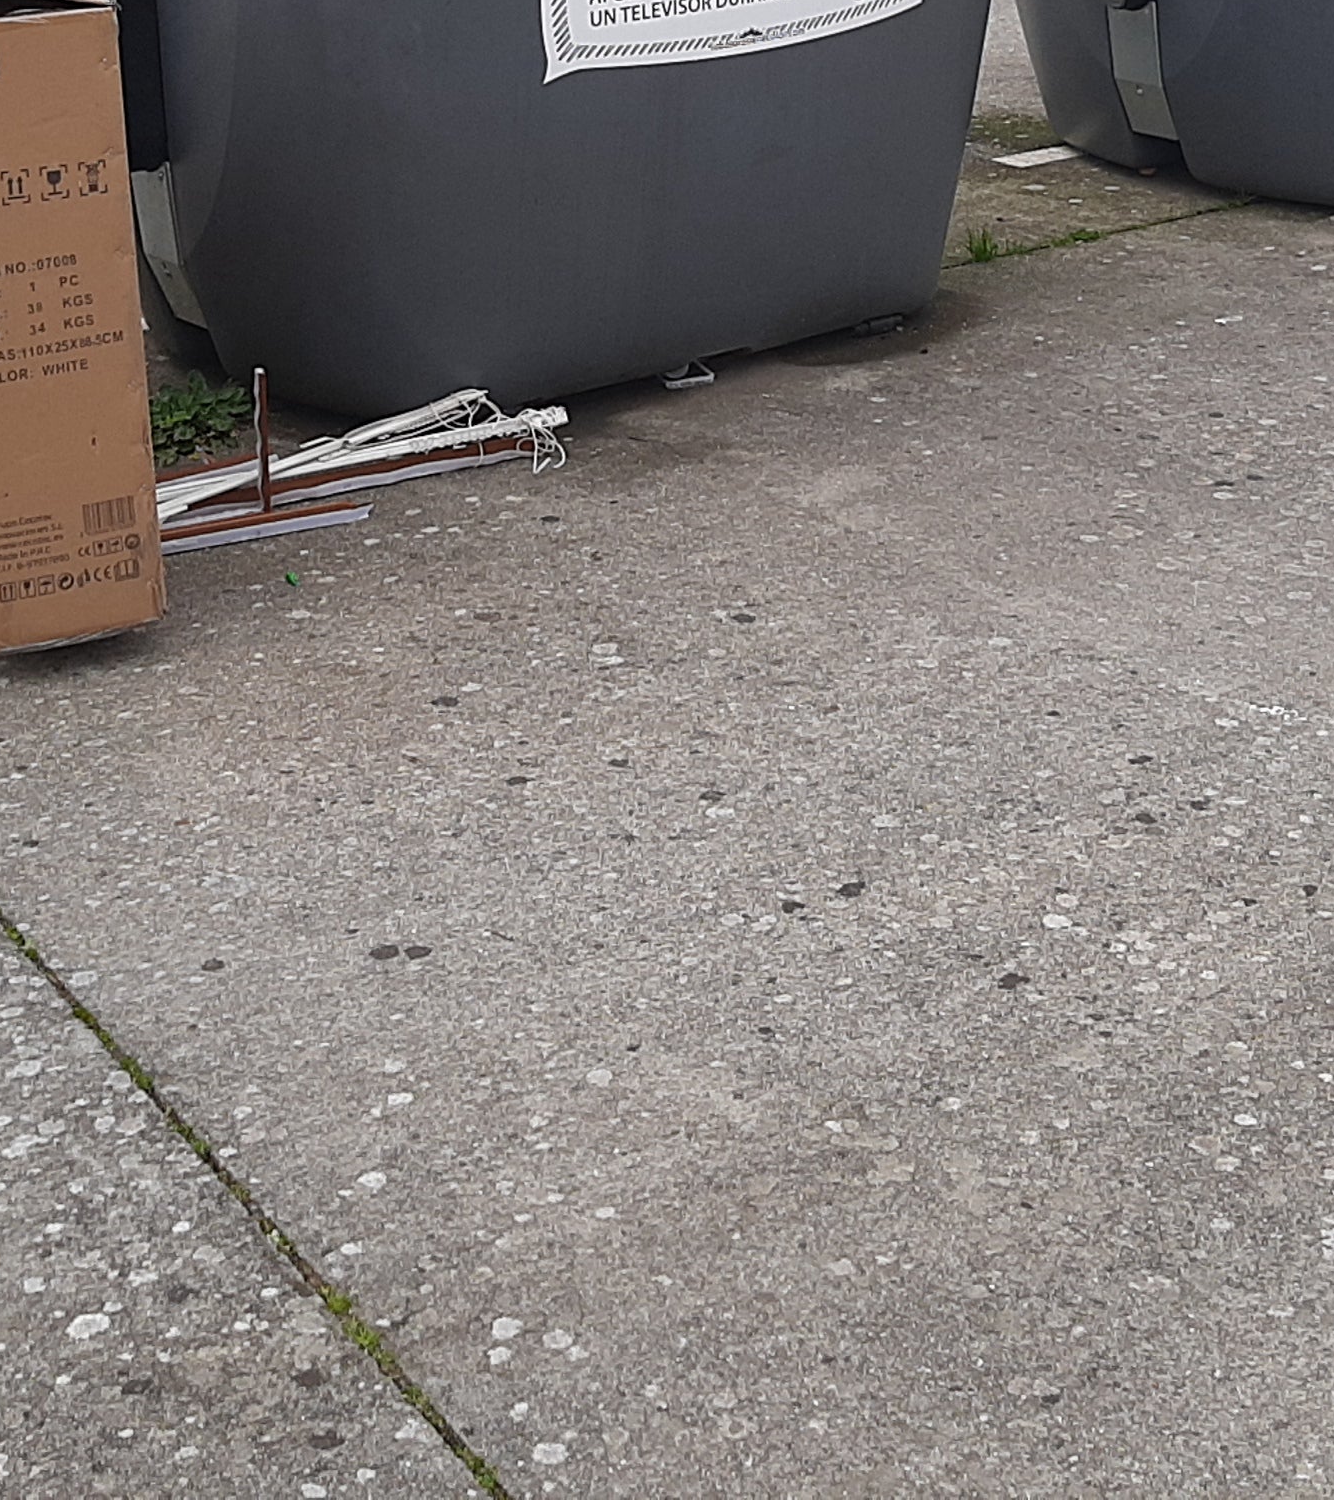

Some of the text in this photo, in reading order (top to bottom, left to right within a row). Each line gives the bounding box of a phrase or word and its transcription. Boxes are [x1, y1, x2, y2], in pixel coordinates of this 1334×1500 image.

[590, 7, 616, 27] UN
[59, 275, 80, 287] PC
[62, 293, 94, 308] KGS
[63, 315, 95, 329] KGS
[42, 359, 89, 376] WHITE
